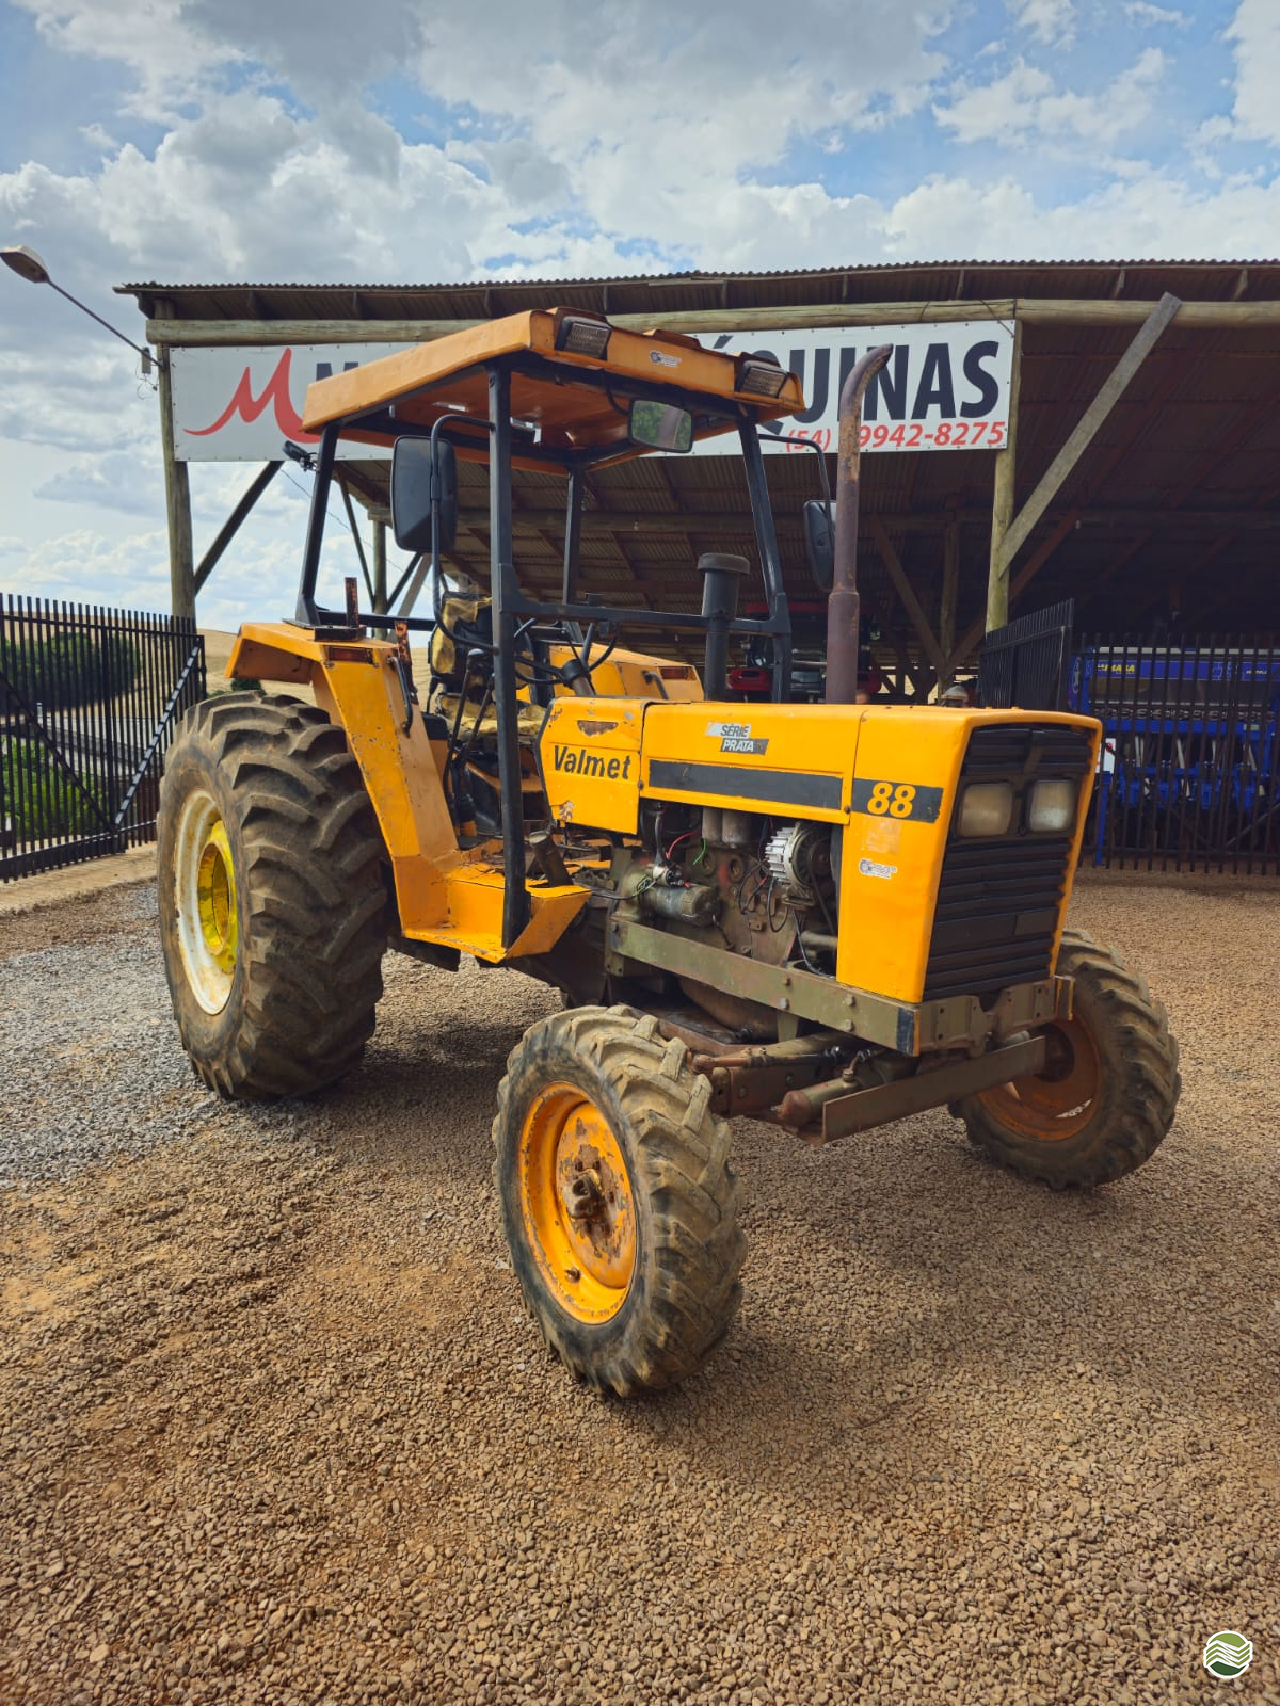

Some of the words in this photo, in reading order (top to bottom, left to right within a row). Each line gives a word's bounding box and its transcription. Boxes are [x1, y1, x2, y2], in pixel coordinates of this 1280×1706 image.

[786, 428, 831, 452] (54)
[721, 739, 754, 753] PRATA
[554, 744, 631, 780] Valmet
[867, 782, 916, 818] 88
